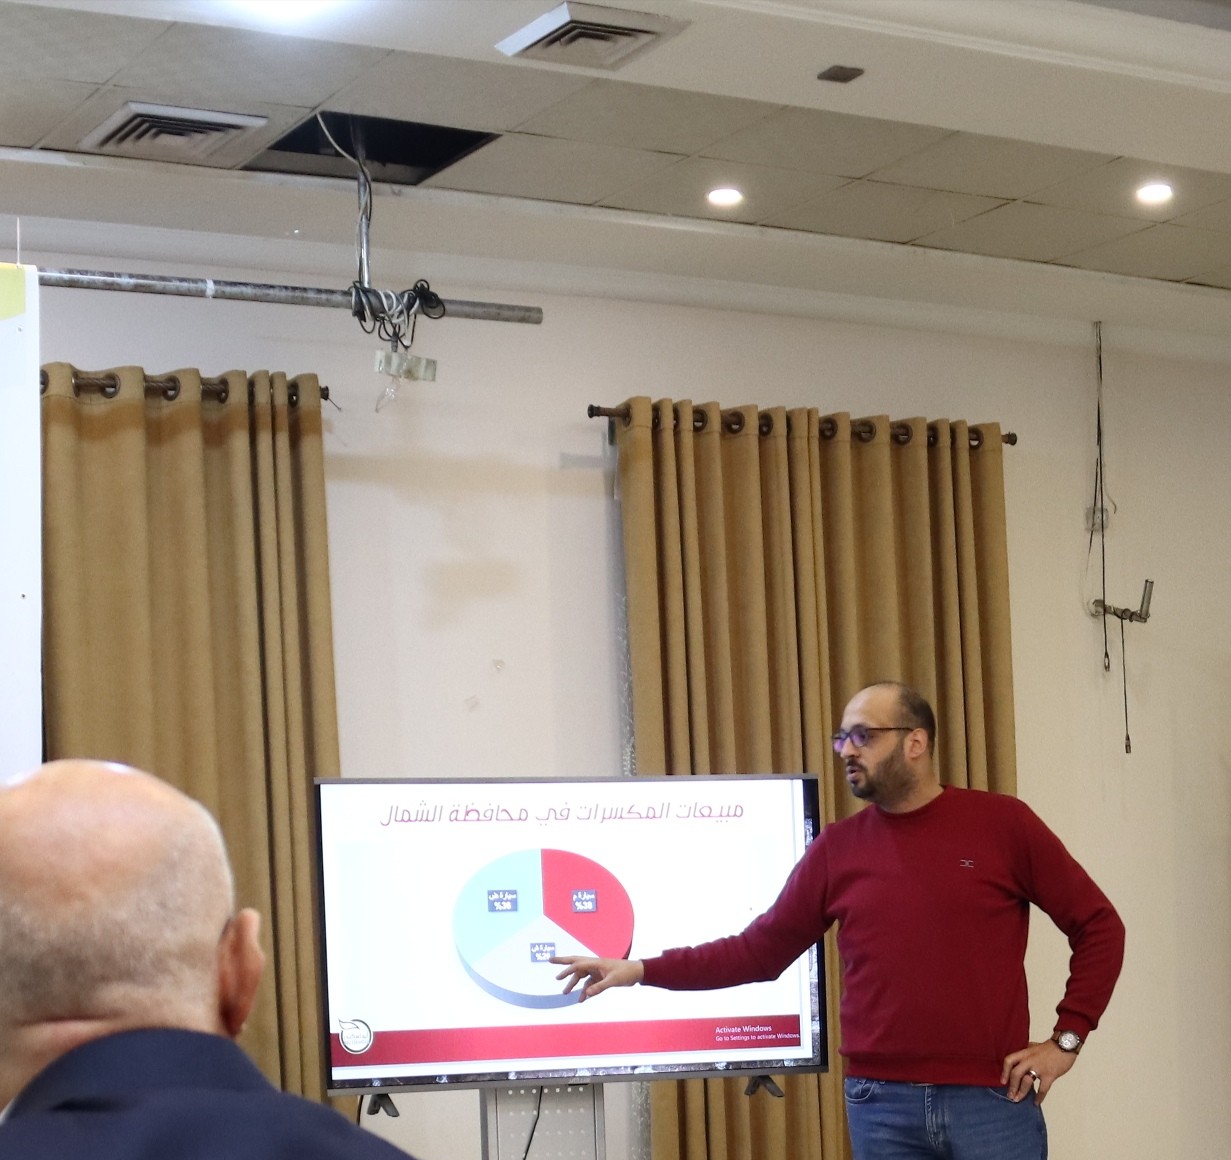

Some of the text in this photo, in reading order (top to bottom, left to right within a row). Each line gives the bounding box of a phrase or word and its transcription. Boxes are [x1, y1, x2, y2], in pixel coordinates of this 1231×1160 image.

[380, 799, 744, 827] مبيعات المكسرات في محافظة الشمال
[730, 1034, 750, 1042] Settings
